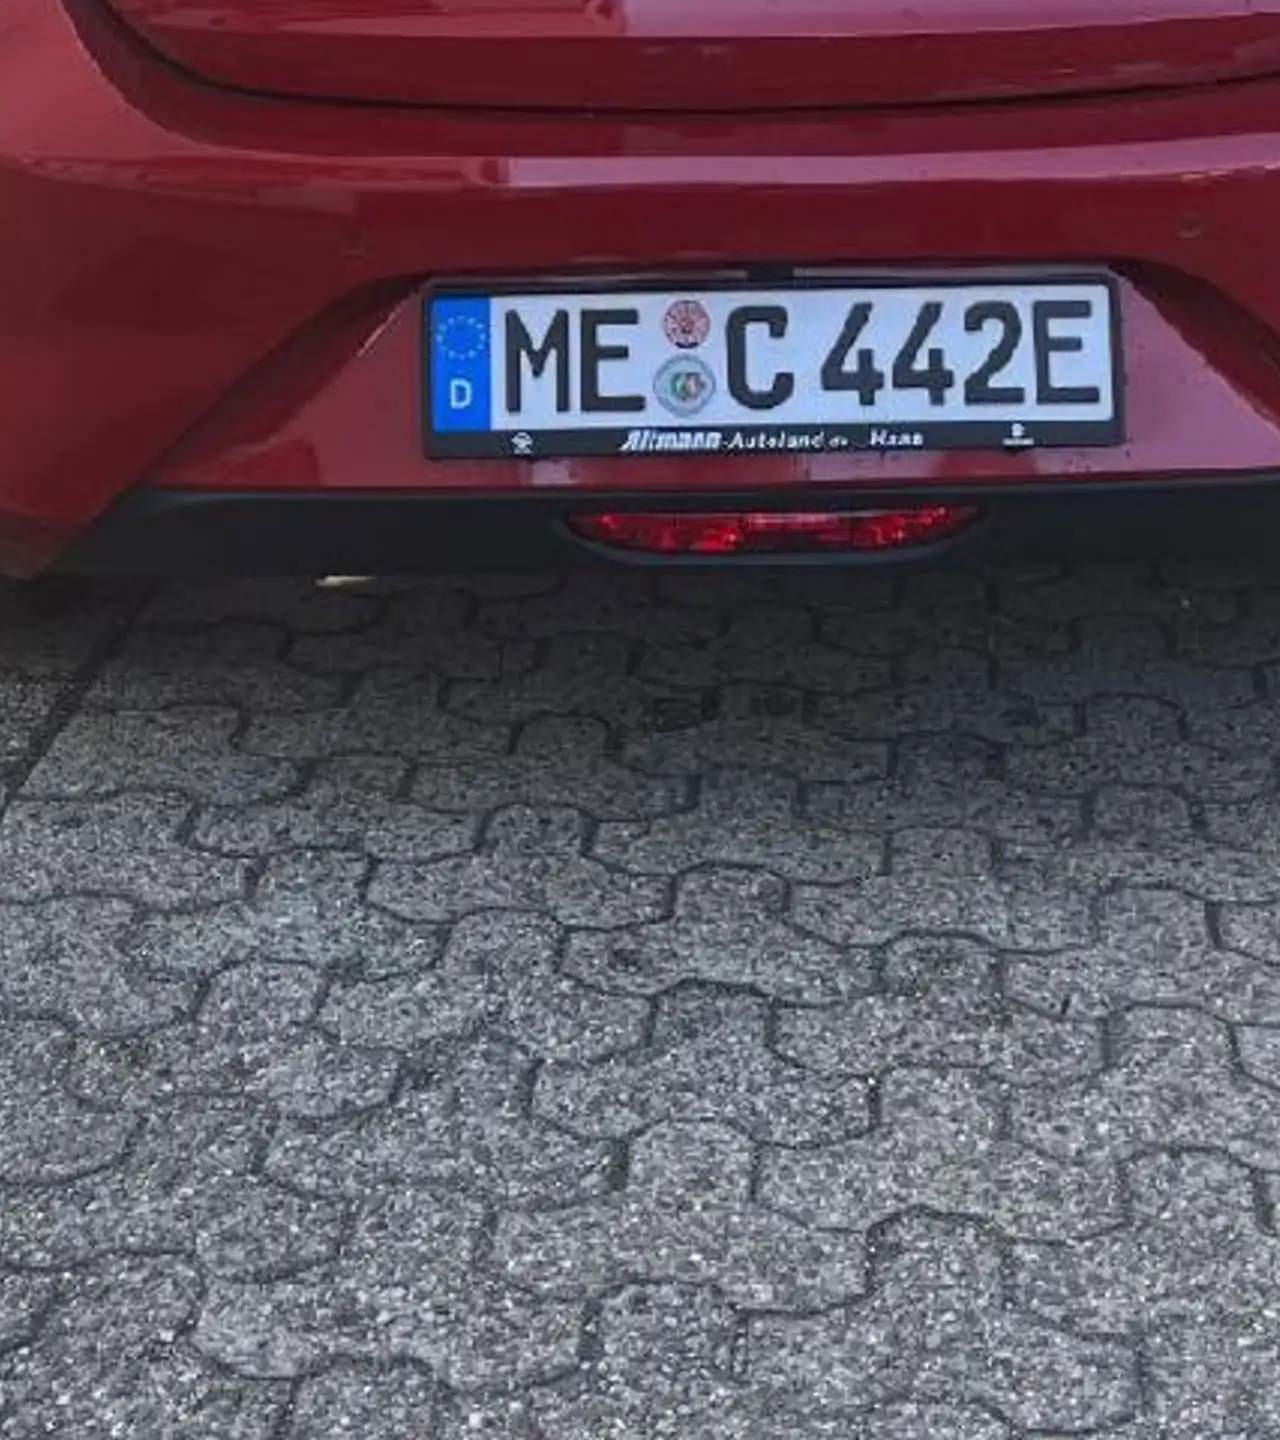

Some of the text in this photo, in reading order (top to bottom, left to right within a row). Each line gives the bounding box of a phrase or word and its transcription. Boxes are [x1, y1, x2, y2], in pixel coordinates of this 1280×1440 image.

[504, 299, 1101, 413] ME C 442E
[449, 378, 472, 410] D
